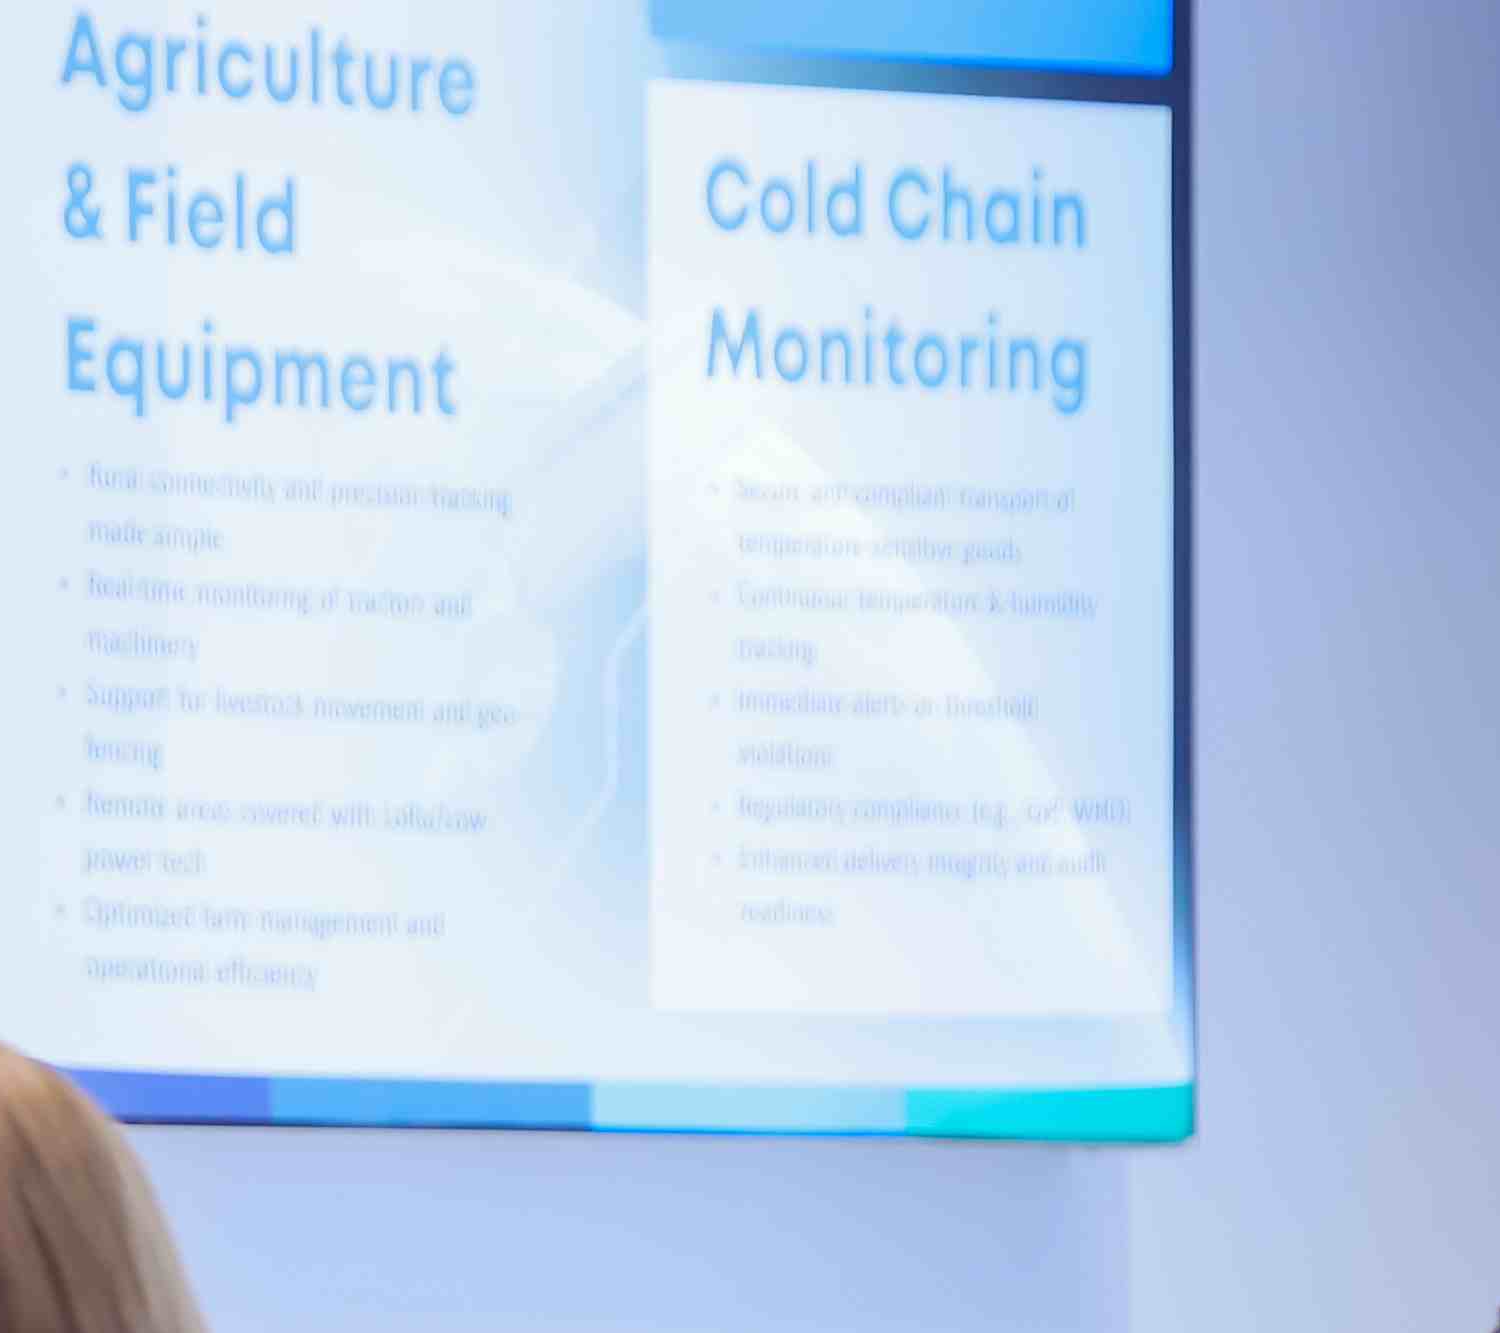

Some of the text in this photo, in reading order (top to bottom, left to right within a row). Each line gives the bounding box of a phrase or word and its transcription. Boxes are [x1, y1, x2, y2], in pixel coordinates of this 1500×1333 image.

[62, 10, 477, 114] Agriculture
[64, 162, 296, 255] & Field
[706, 158, 1087, 248] Cold Chain
[65, 317, 458, 424] Equipment
[705, 305, 1087, 416] Monitoring
